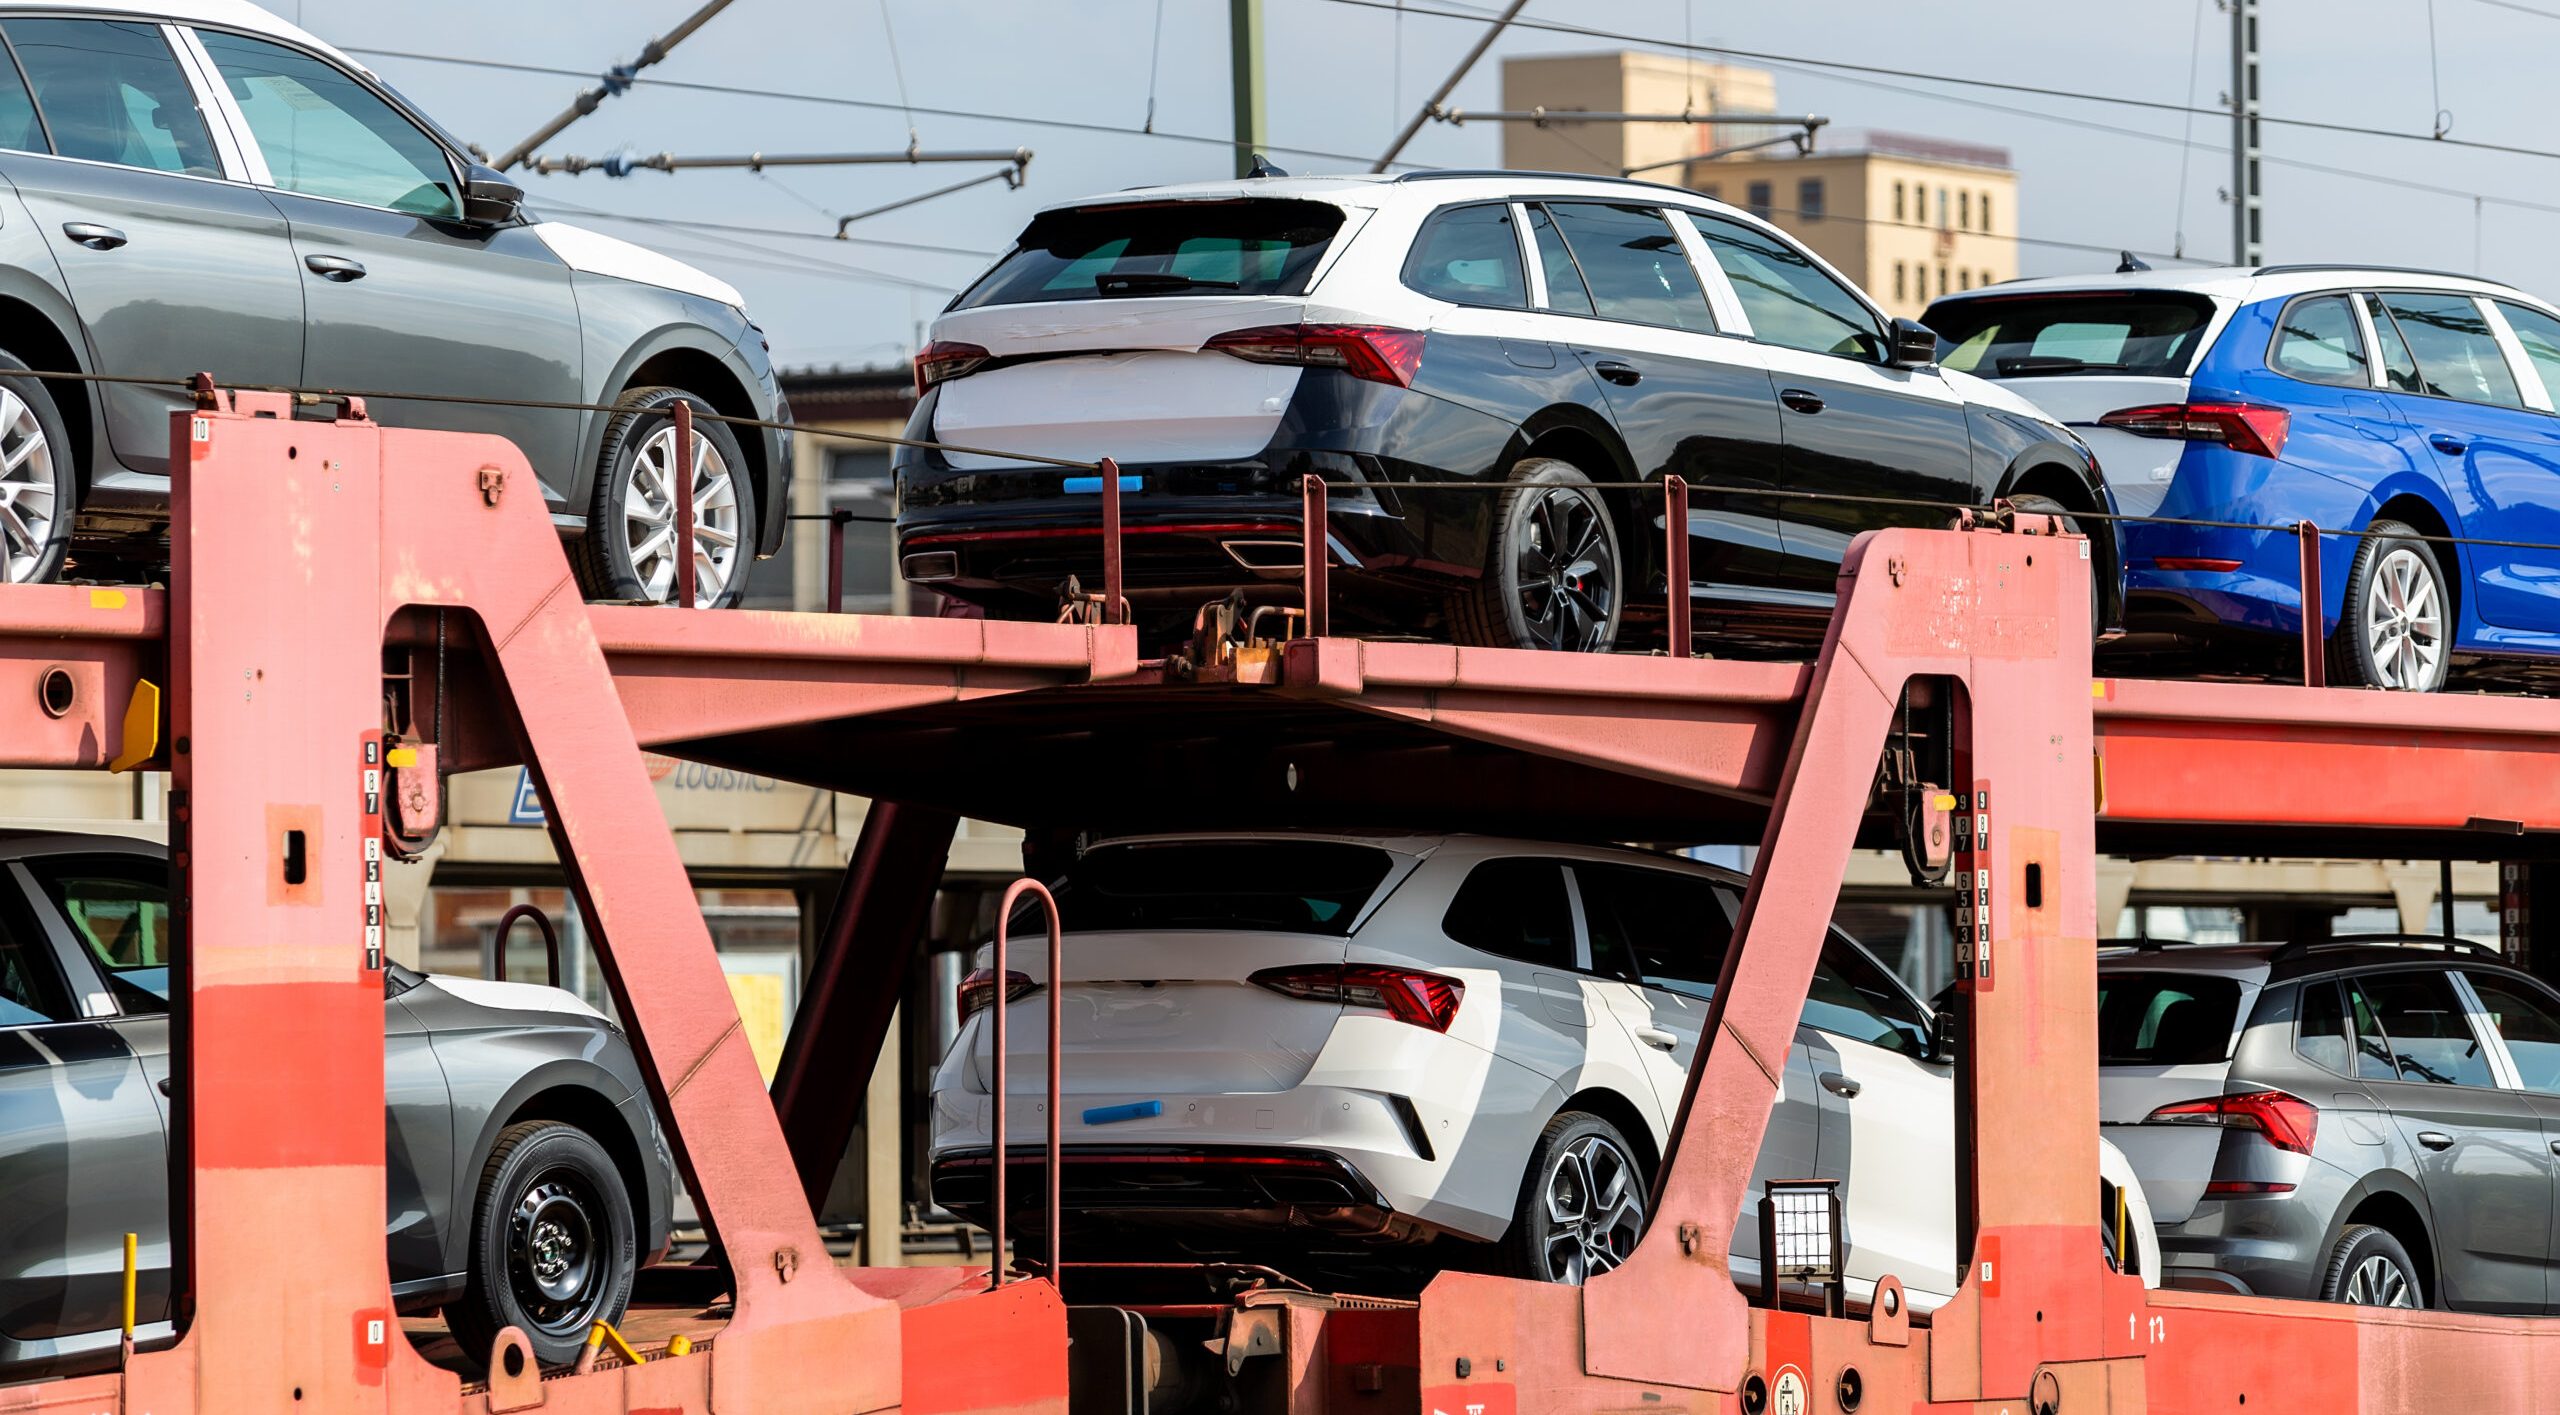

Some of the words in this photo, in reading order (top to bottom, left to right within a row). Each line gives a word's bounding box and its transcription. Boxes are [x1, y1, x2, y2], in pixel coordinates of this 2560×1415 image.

[194, 420, 206, 439] 10
[2080, 541, 2088, 557] 10
[367, 743, 376, 763] 9
[368, 793, 377, 814] 7
[1959, 794, 1967, 810] 9
[368, 861, 377, 881] 5
[369, 905, 378, 926] 3
[370, 949, 377, 969] 1
